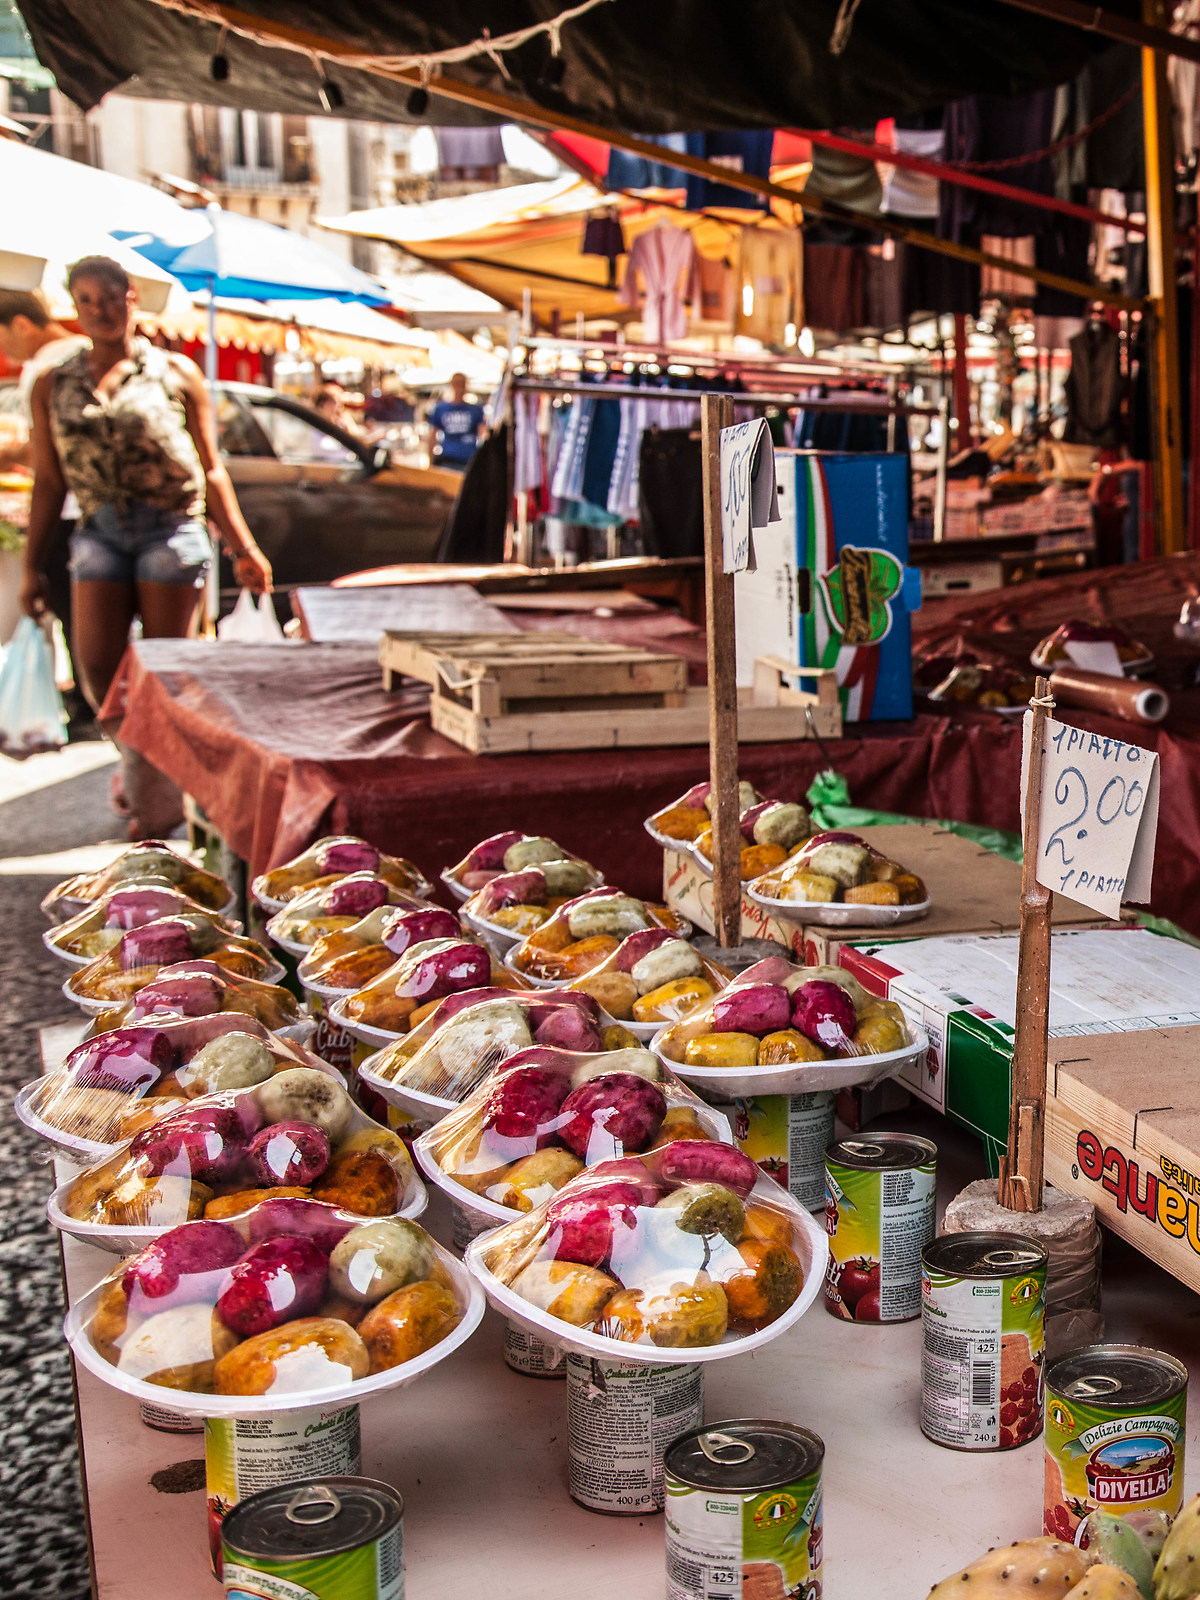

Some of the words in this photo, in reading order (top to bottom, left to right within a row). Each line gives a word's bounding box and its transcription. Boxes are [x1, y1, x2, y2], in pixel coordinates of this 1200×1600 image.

[1066, 733, 1141, 763] PIATTO
[977, 1343, 995, 1352] 425
[605, 1368, 638, 1379] Cubetti
[638, 1367, 649, 1378] di
[974, 1433, 990, 1442] 240
[1084, 1422, 1123, 1446] Delizie
[1124, 1420, 1179, 1434] Campagnole
[1099, 1474, 1167, 1499] DIVELLA
[616, 1496, 633, 1505] 400
[712, 1572, 734, 1583] 425
